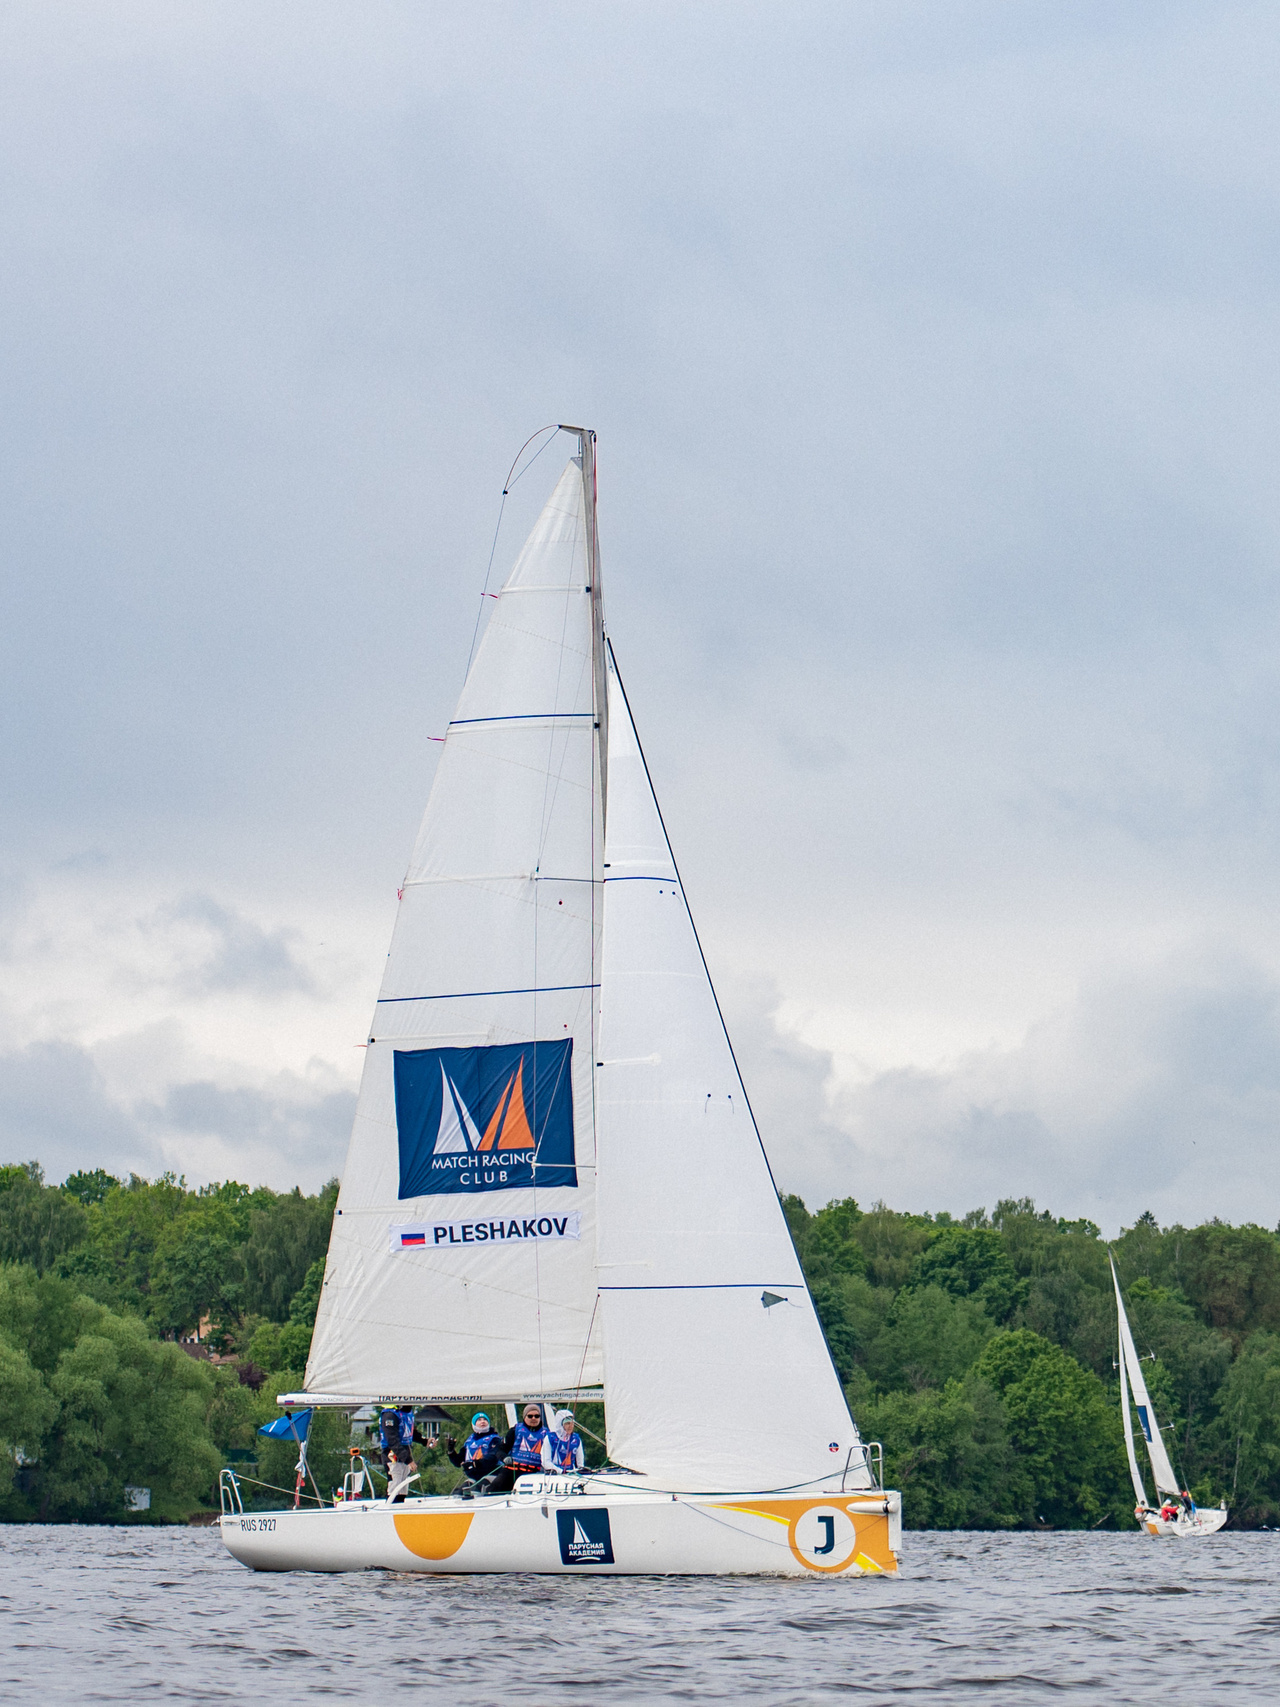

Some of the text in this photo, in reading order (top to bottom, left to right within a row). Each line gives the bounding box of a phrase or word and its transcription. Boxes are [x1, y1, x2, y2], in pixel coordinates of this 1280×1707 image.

[431, 1152, 536, 1169] MATCH RACING
[460, 1171, 508, 1185] CLUB
[433, 1217, 568, 1244] PLESHAKOV
[241, 1518, 277, 1532] RUS 2927
[814, 1516, 835, 1555] J
